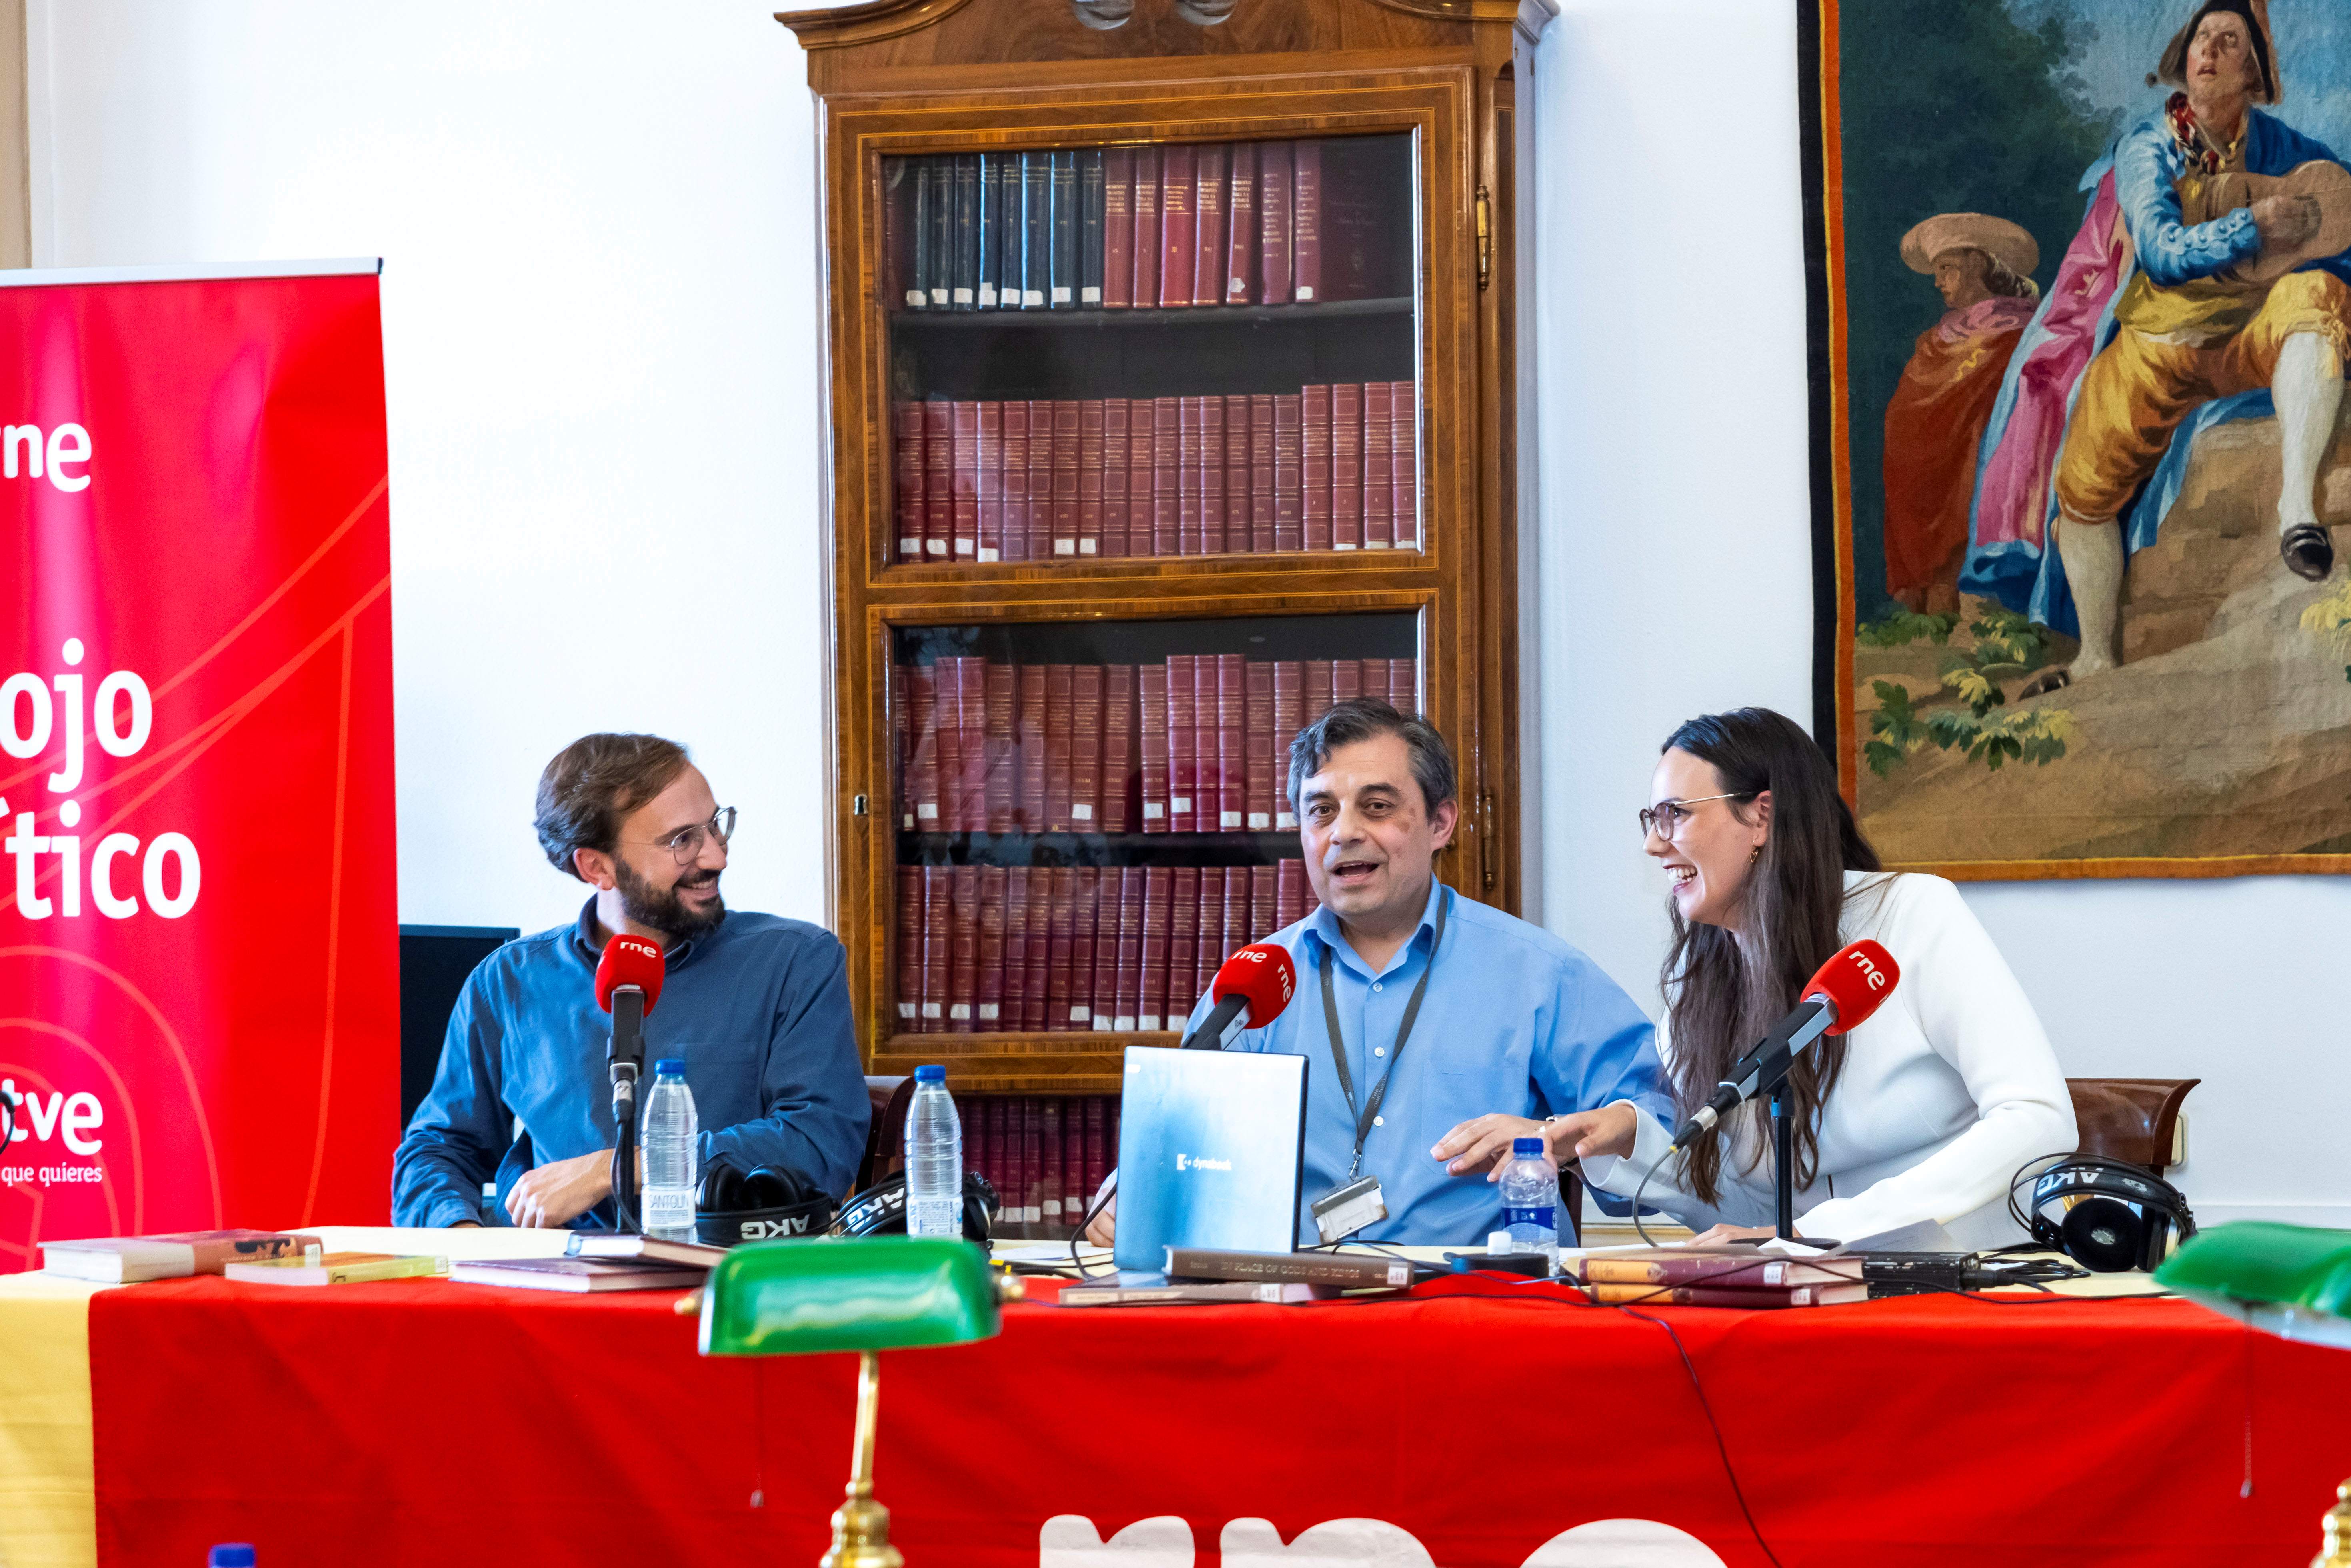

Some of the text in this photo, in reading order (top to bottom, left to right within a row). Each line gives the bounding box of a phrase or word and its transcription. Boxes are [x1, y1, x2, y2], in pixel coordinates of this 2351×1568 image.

[0, 423, 92, 492] ne
[0, 638, 152, 793] ojo
[0, 797, 201, 920] tico
[620, 942, 657, 958] rne
[1277, 964, 1291, 1002] rne
[1849, 950, 1885, 990] rne
[1, 1162, 103, 1187] que quieres
[2037, 1167, 2104, 1196] AKG
[741, 1214, 810, 1240] AKG
[846, 1187, 905, 1232] AKG
